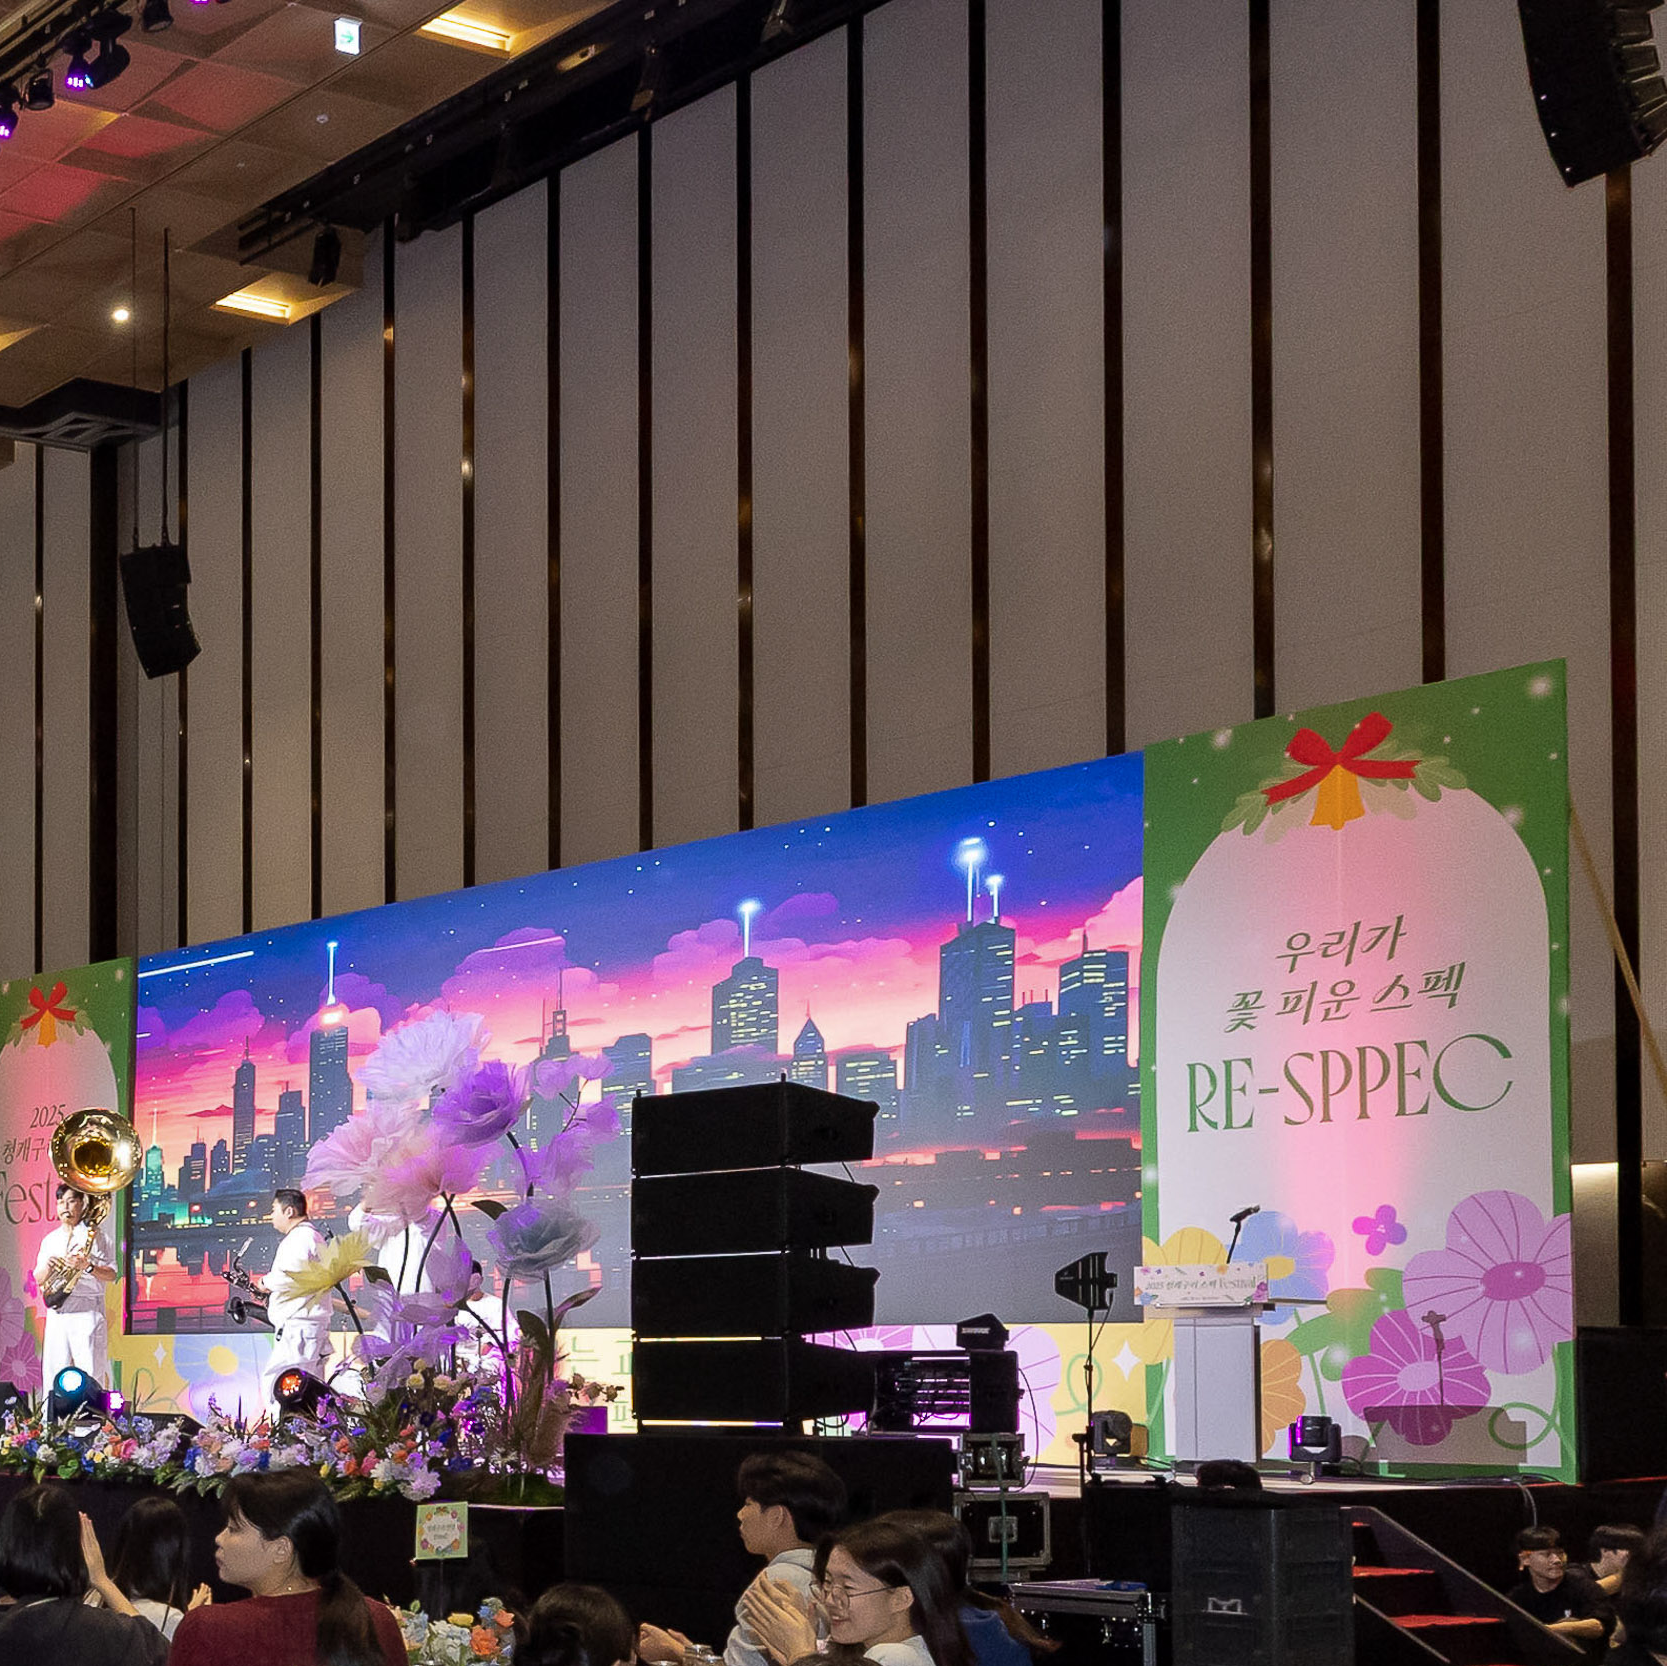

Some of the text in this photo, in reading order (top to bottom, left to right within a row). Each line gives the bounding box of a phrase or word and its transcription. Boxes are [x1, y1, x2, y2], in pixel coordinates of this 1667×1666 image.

[1275, 914, 1408, 974] 우리가
[1224, 961, 1467, 1035] 꽃 피운 스펙
[1185, 1033, 1515, 1134] RE-SPPEC
[3, 1137, 51, 1165] 청개구
